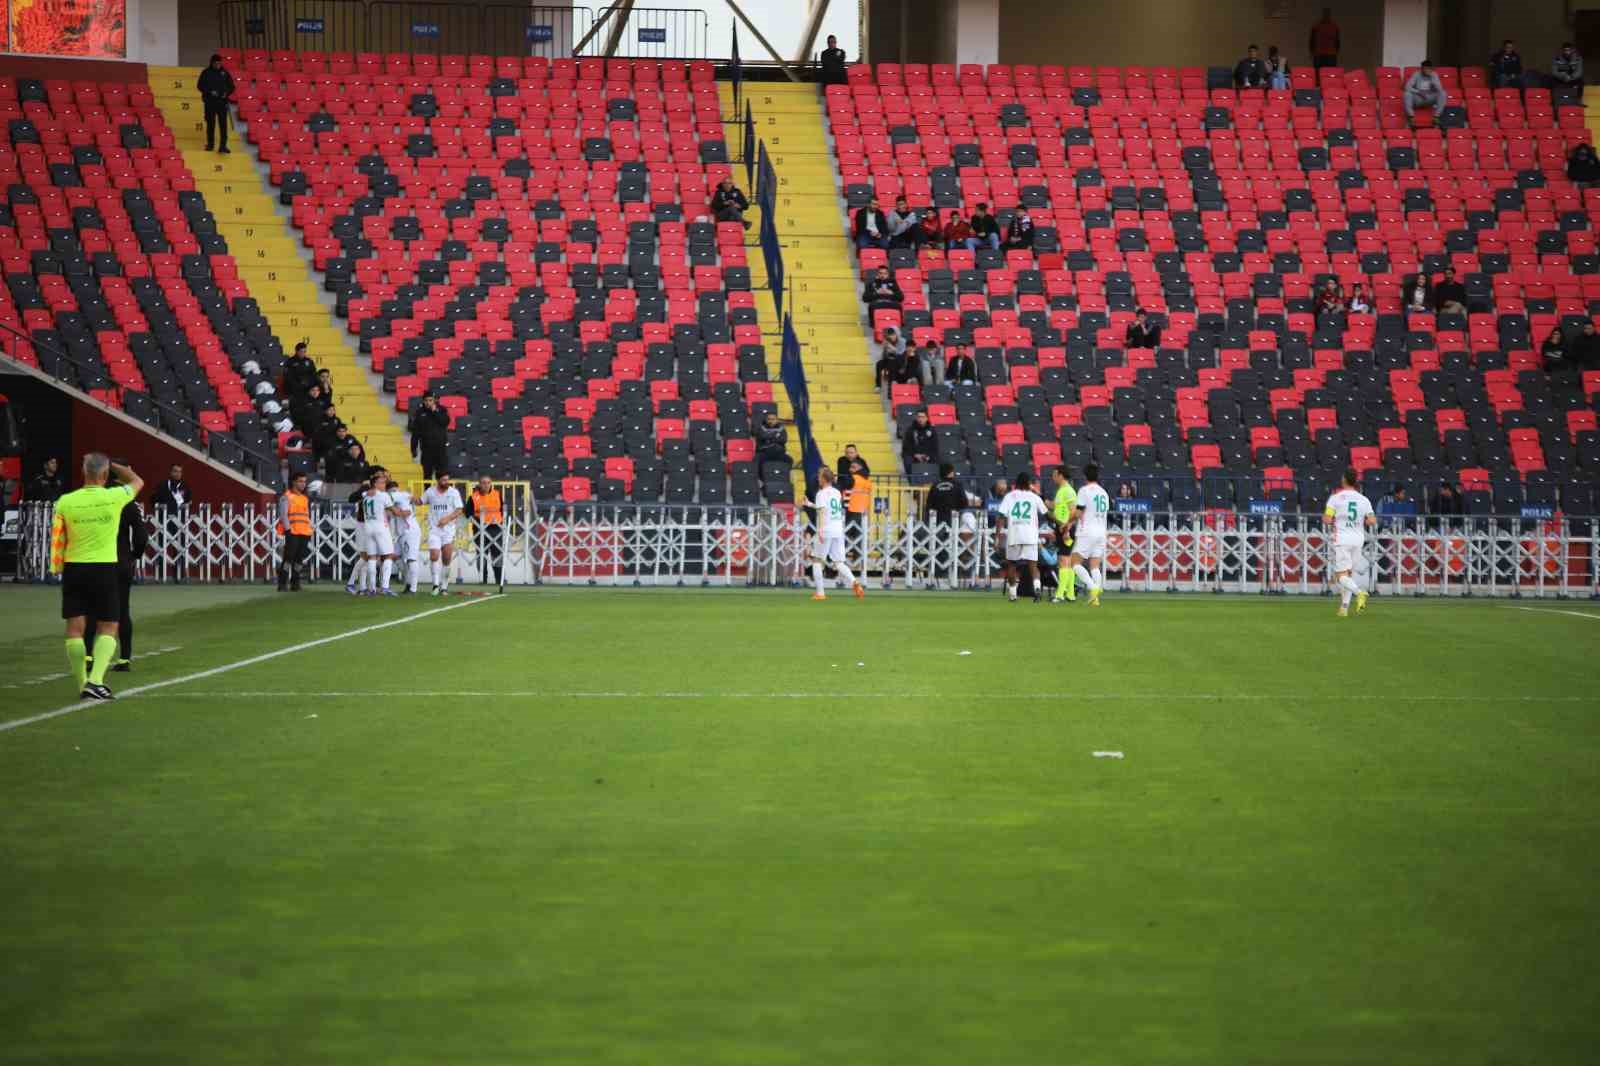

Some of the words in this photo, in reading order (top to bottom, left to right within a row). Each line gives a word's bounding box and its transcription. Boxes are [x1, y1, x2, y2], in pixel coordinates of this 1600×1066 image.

[364, 499, 375, 516] 11
[830, 497, 842, 516] 94
[1011, 501, 1032, 519] 42
[1093, 494, 1107, 513] 16
[1347, 501, 1357, 522] 5
